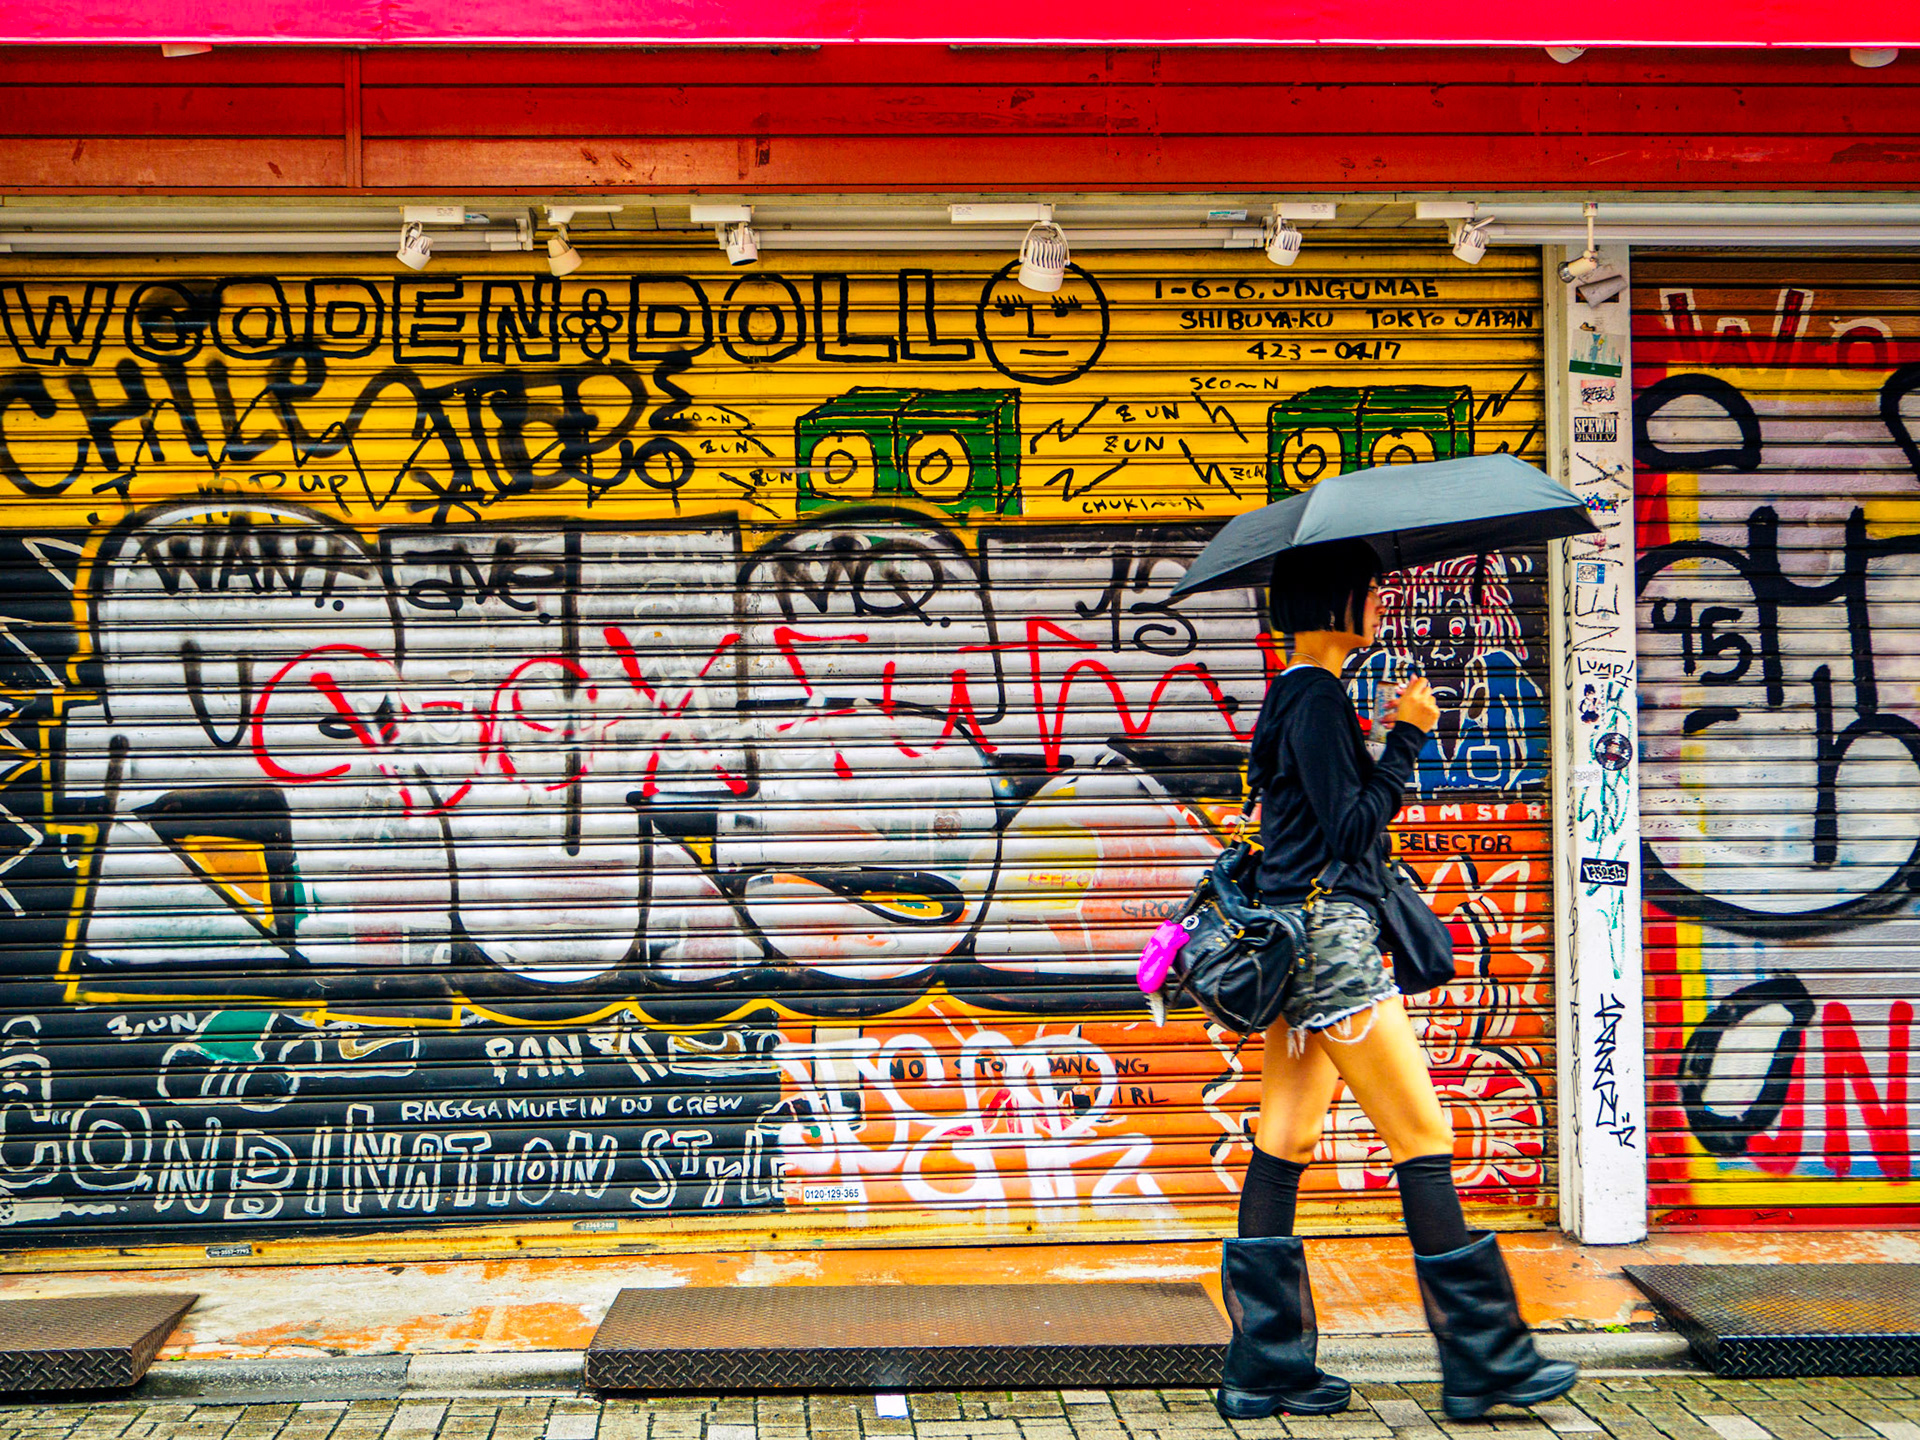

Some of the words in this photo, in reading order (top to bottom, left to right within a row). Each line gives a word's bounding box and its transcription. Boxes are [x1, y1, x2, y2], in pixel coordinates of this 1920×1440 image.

[1179, 311, 1335, 331] SHIBUYA-KU
[1454, 309, 1534, 329] JAPAN
[1116, 401, 1180, 423] ZUN
[1103, 436, 1165, 453] ZUN
[1398, 833, 1512, 852] SELECTOR
[621, 1096, 653, 1114] DJ
[668, 1096, 743, 1115] CREW
[804, 1188, 859, 1199] 0120-129-365
